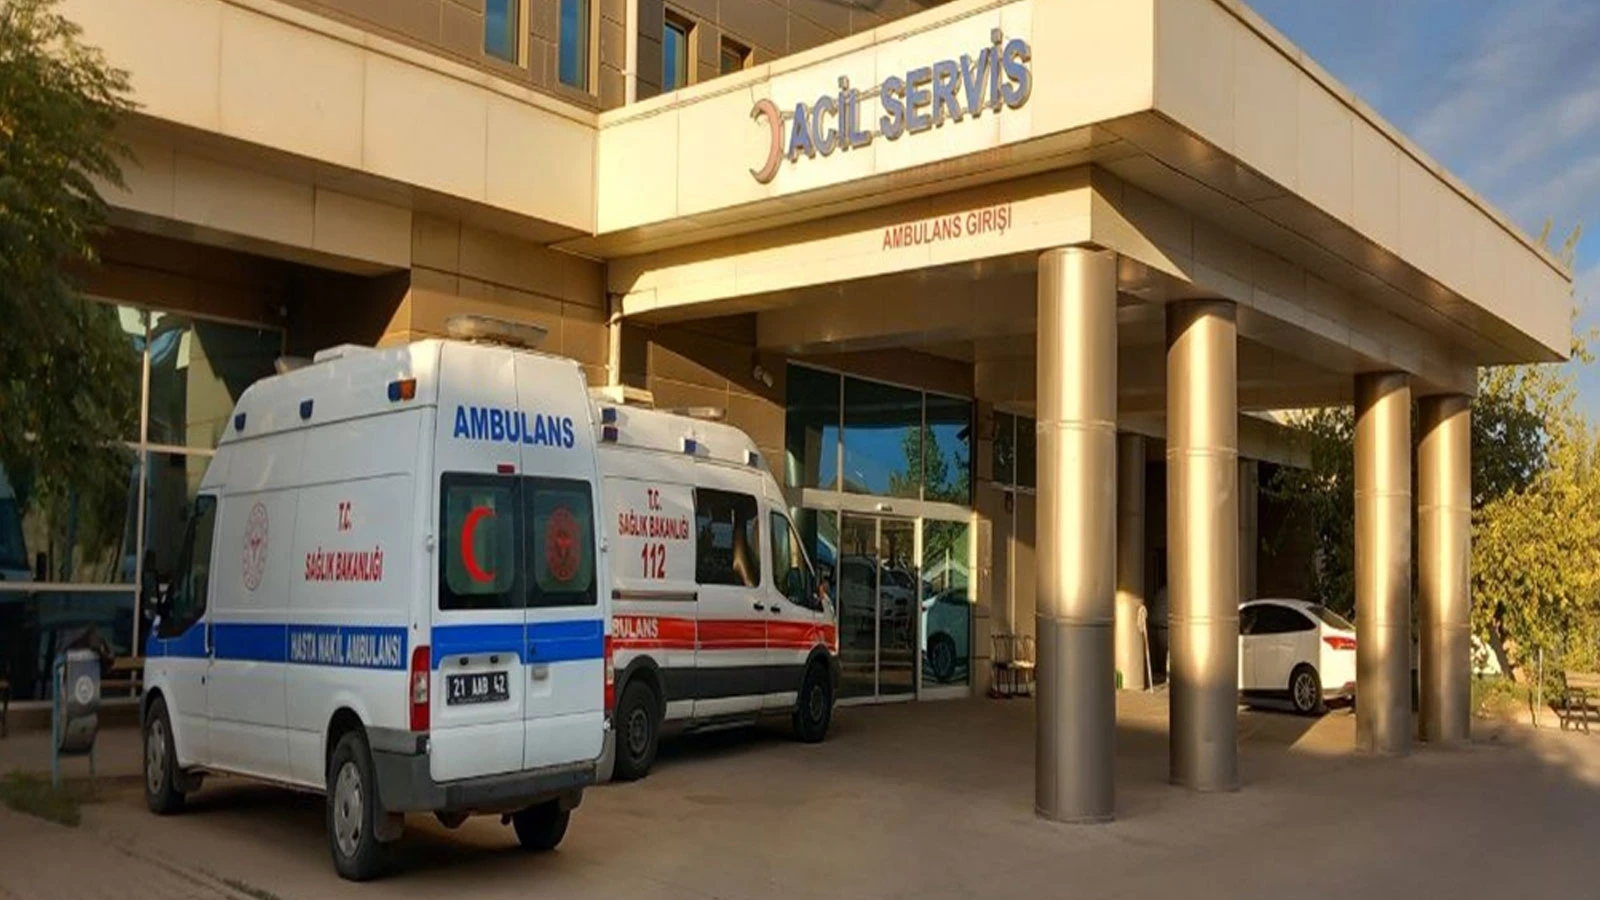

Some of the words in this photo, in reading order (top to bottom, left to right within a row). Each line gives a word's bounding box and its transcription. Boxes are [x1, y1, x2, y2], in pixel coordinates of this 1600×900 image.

[788, 75, 872, 162] ACİL
[880, 28, 1032, 141] SERVİS
[883, 215, 962, 250] AMBULANS
[453, 405, 575, 449] AMBULANS
[618, 509, 648, 538] SAĞLIK
[649, 514, 690, 540] BAKANLIĞI
[304, 546, 334, 581] SAĞLIK
[336, 545, 383, 581] BAKANLIĞI
[641, 543, 666, 579] 112
[290, 631, 317, 661] HASTA
[318, 627, 344, 664] NAKİL
[453, 678, 465, 697] 21
[493, 674, 506, 694] 42
